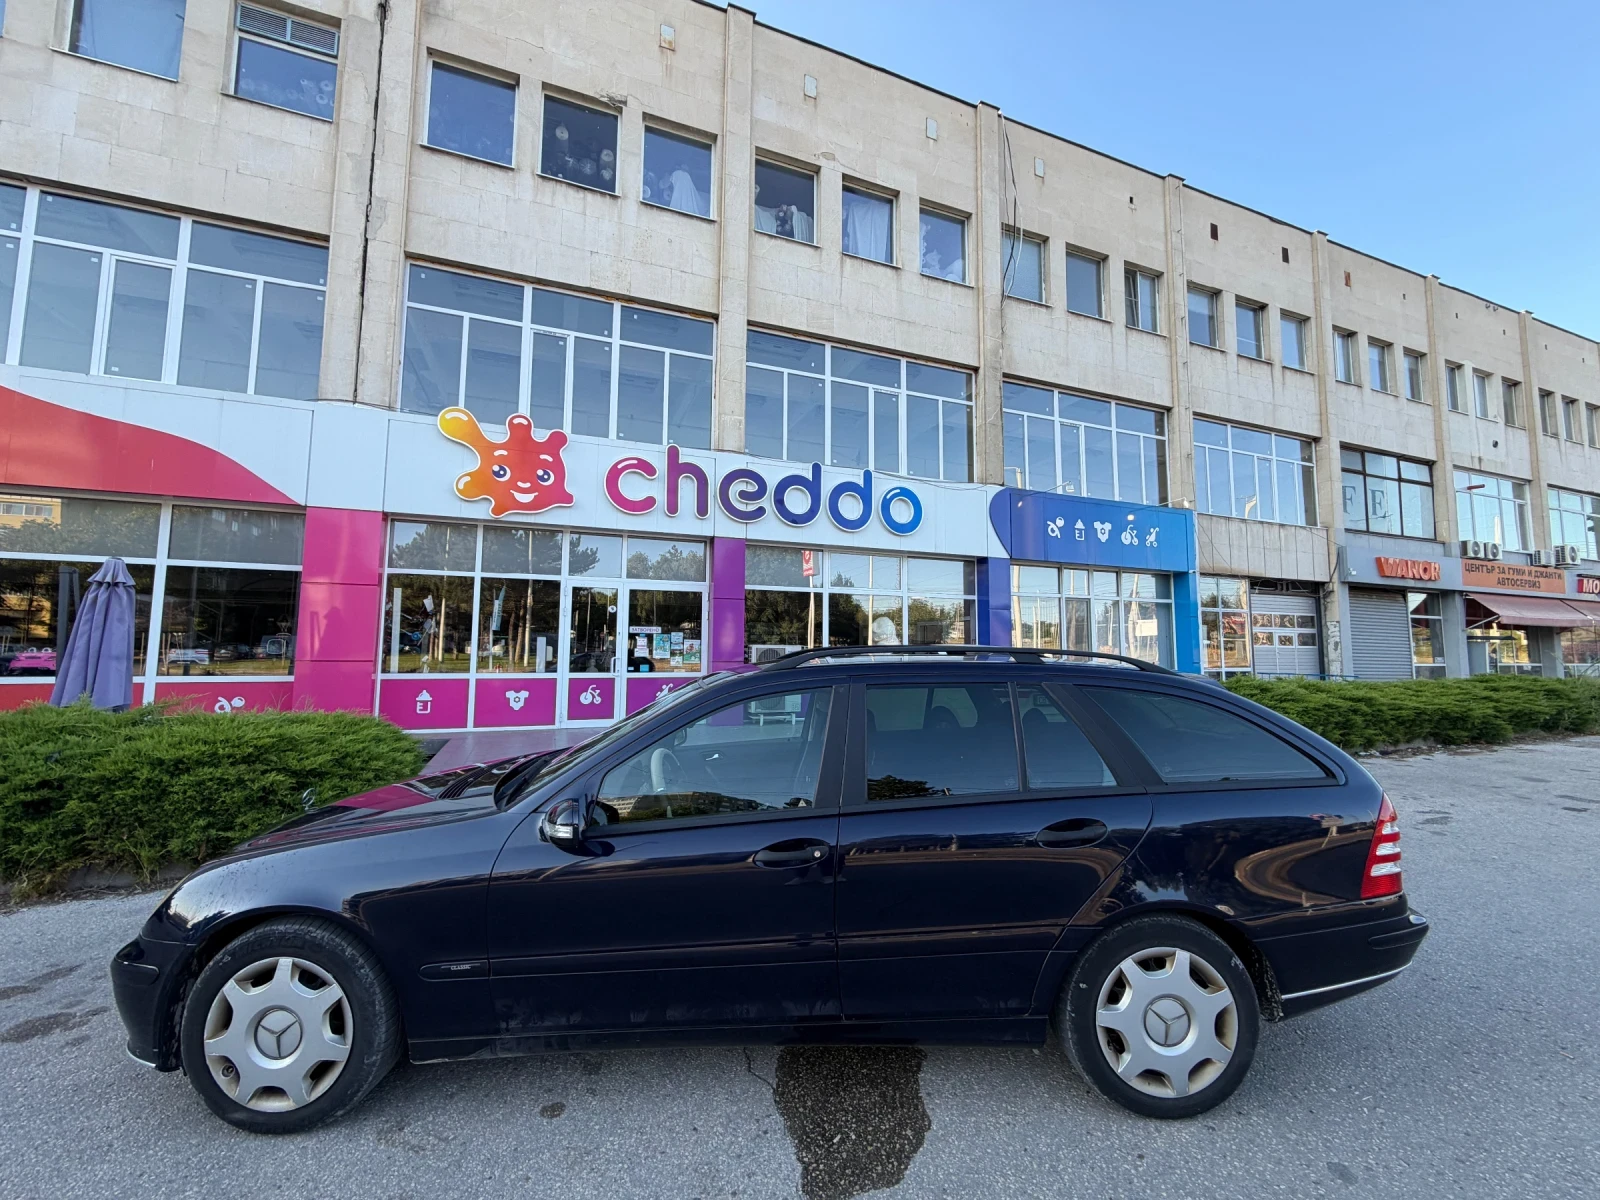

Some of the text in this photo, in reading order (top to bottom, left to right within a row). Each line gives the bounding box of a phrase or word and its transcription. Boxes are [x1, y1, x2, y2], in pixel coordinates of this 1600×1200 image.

[604, 444, 924, 535] cheddo
[1465, 562, 1562, 580] ЦЕНТЪР ЗА ГУМИ И ДЖАНТИ
[1497, 577, 1541, 589] АВТОСЕРВИЗ
